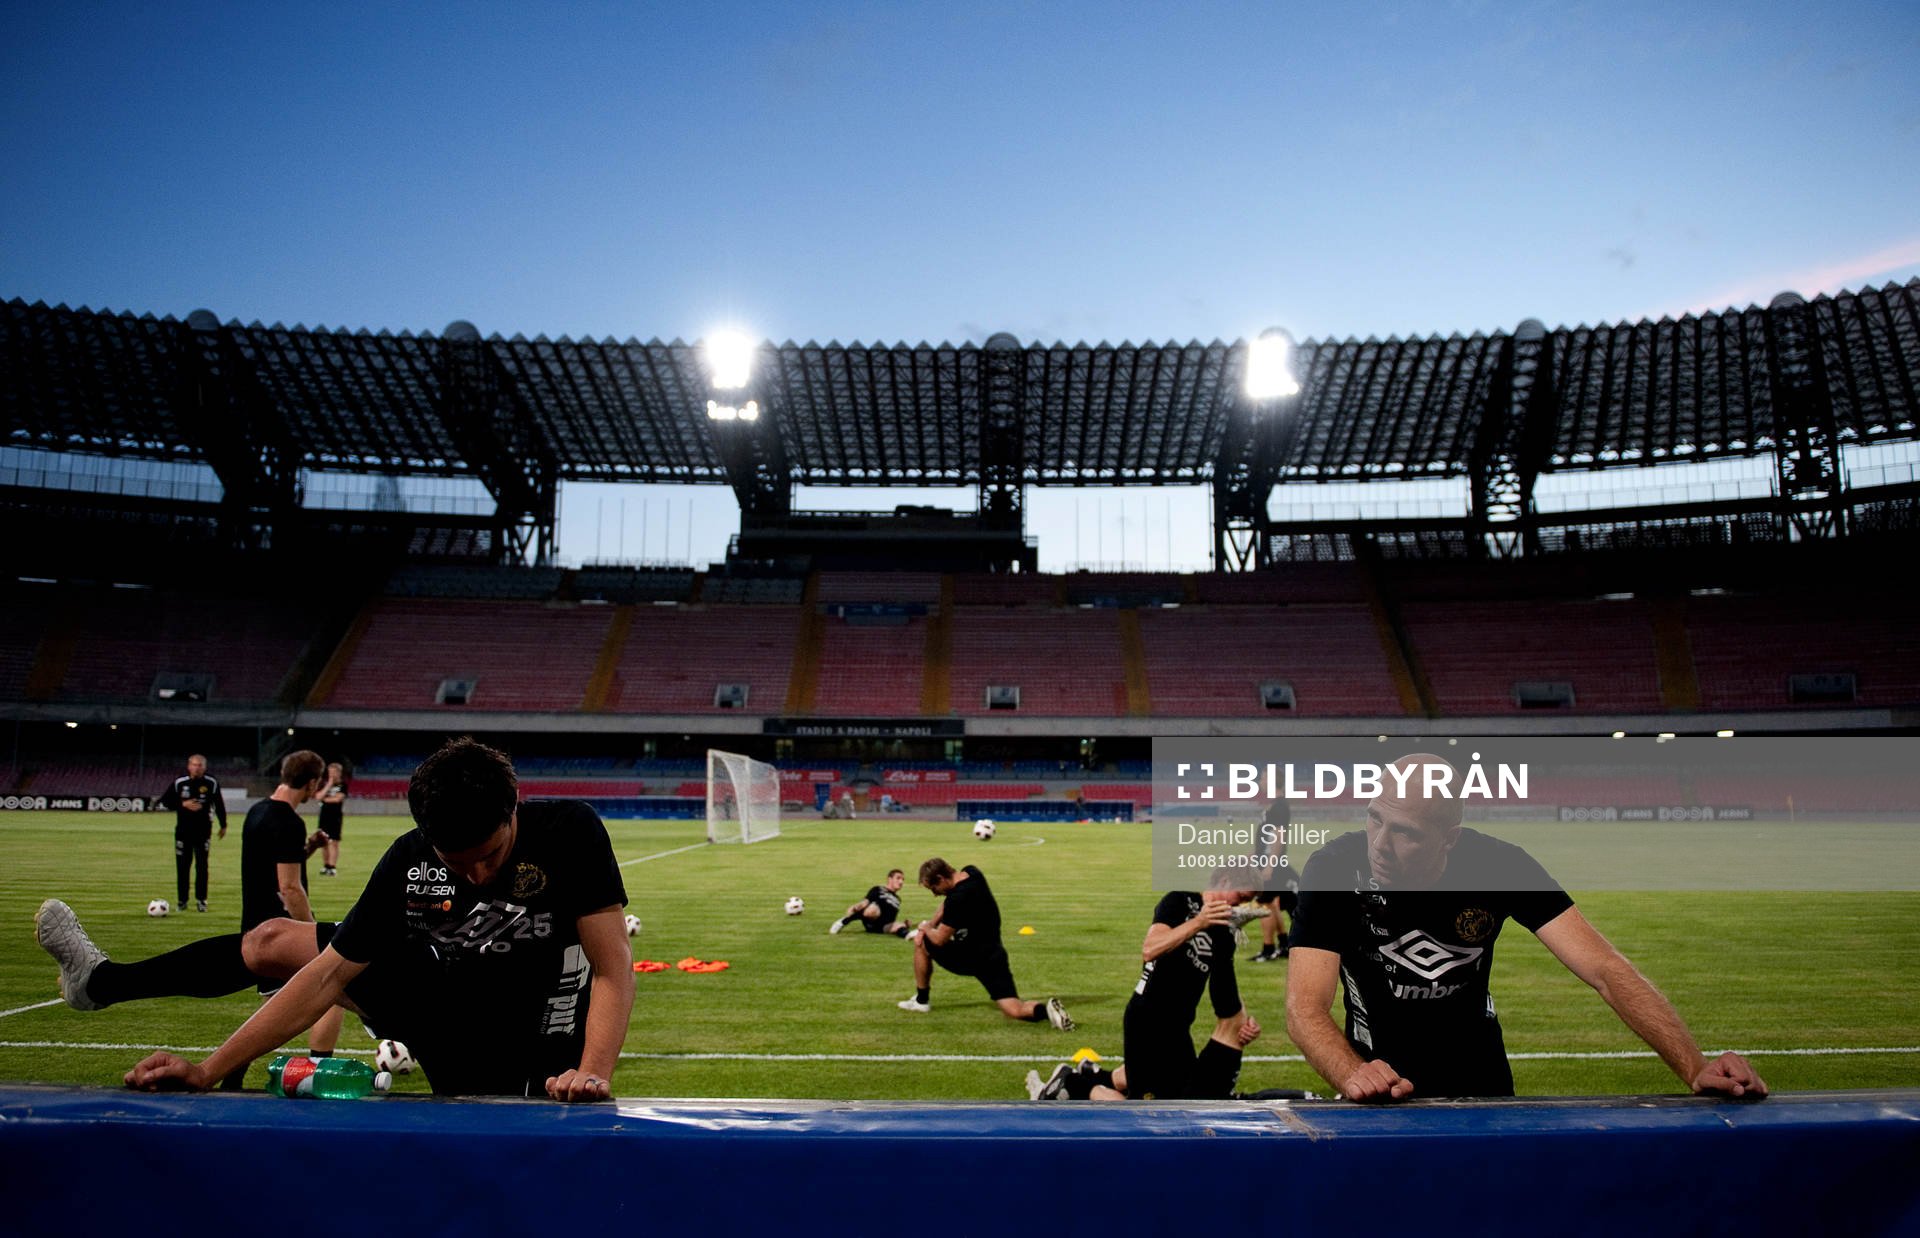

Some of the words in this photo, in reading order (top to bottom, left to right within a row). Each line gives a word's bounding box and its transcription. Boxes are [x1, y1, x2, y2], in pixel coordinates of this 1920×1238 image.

[895, 726, 932, 736] NAPOLI
[0, 796, 47, 810] OOA
[407, 861, 448, 882] ellos
[406, 884, 456, 896] PULSEN
[513, 912, 553, 940] 25
[1388, 981, 1467, 1000] umbr
